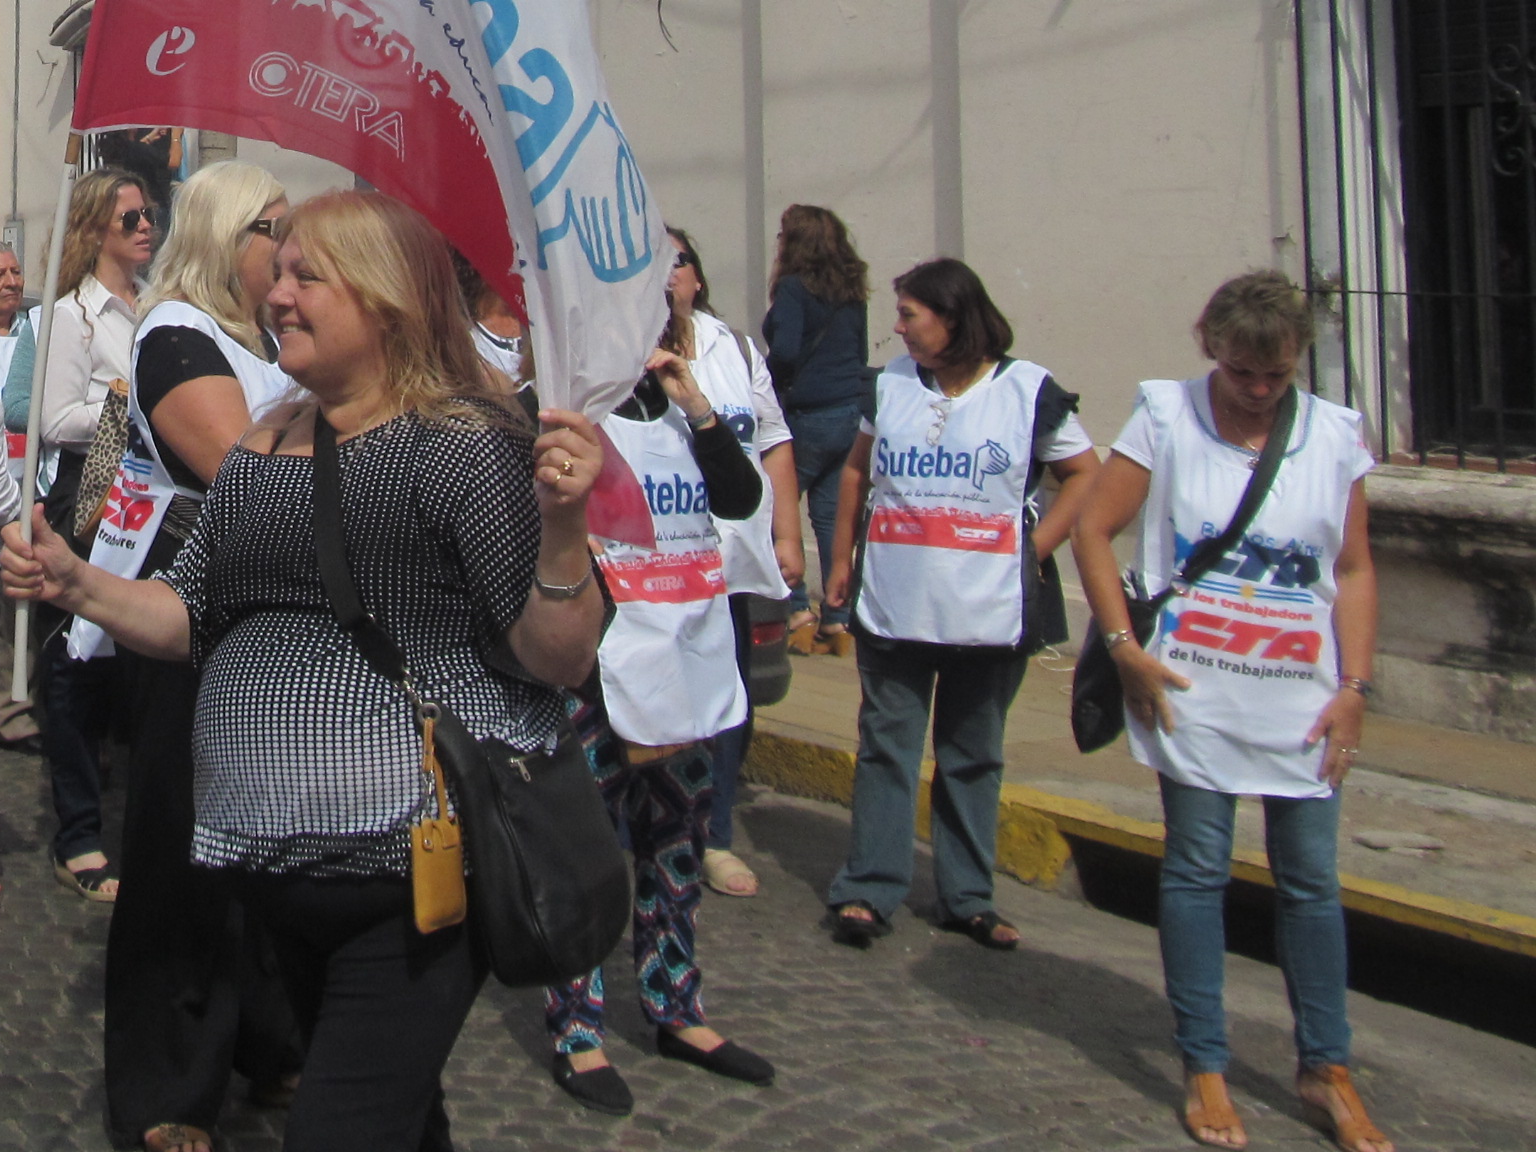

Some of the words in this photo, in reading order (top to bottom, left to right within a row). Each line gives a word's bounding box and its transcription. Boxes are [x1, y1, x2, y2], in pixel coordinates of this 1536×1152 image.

[247, 51, 406, 163] CTERA
[876, 437, 972, 478] Suteba
[643, 473, 710, 516] teba
[642, 576, 686, 592] CTERA
[1195, 590, 1216, 605] los
[1172, 610, 1323, 664] CTA
[1169, 648, 1188, 661] de
[1192, 649, 1215, 667] los
[1217, 659, 1315, 680] trabajadores
